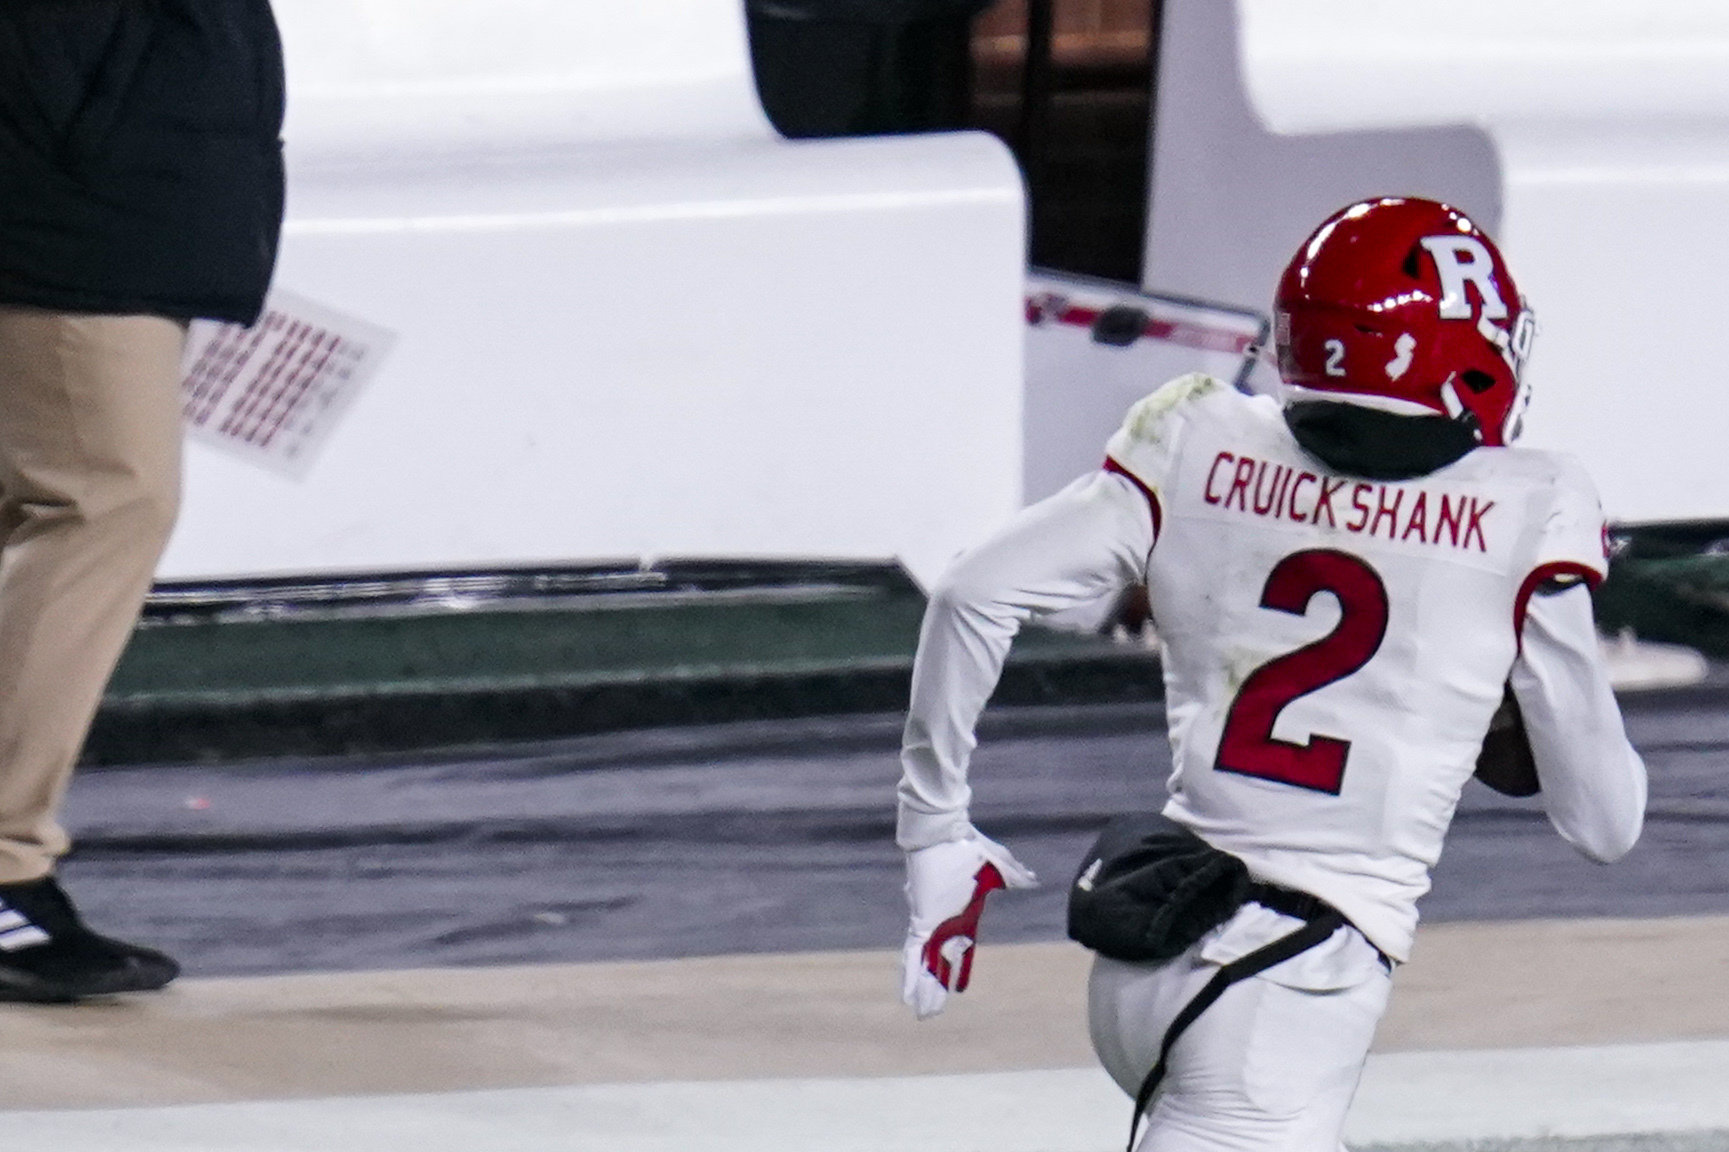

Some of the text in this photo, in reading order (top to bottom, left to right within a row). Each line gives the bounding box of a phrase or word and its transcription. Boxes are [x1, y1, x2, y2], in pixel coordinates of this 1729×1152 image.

[1420, 235, 1508, 320] R
[1324, 339, 1346, 377] 2
[1204, 451, 1496, 553] CRUICKSHANK
[1213, 548, 1389, 796] 2
